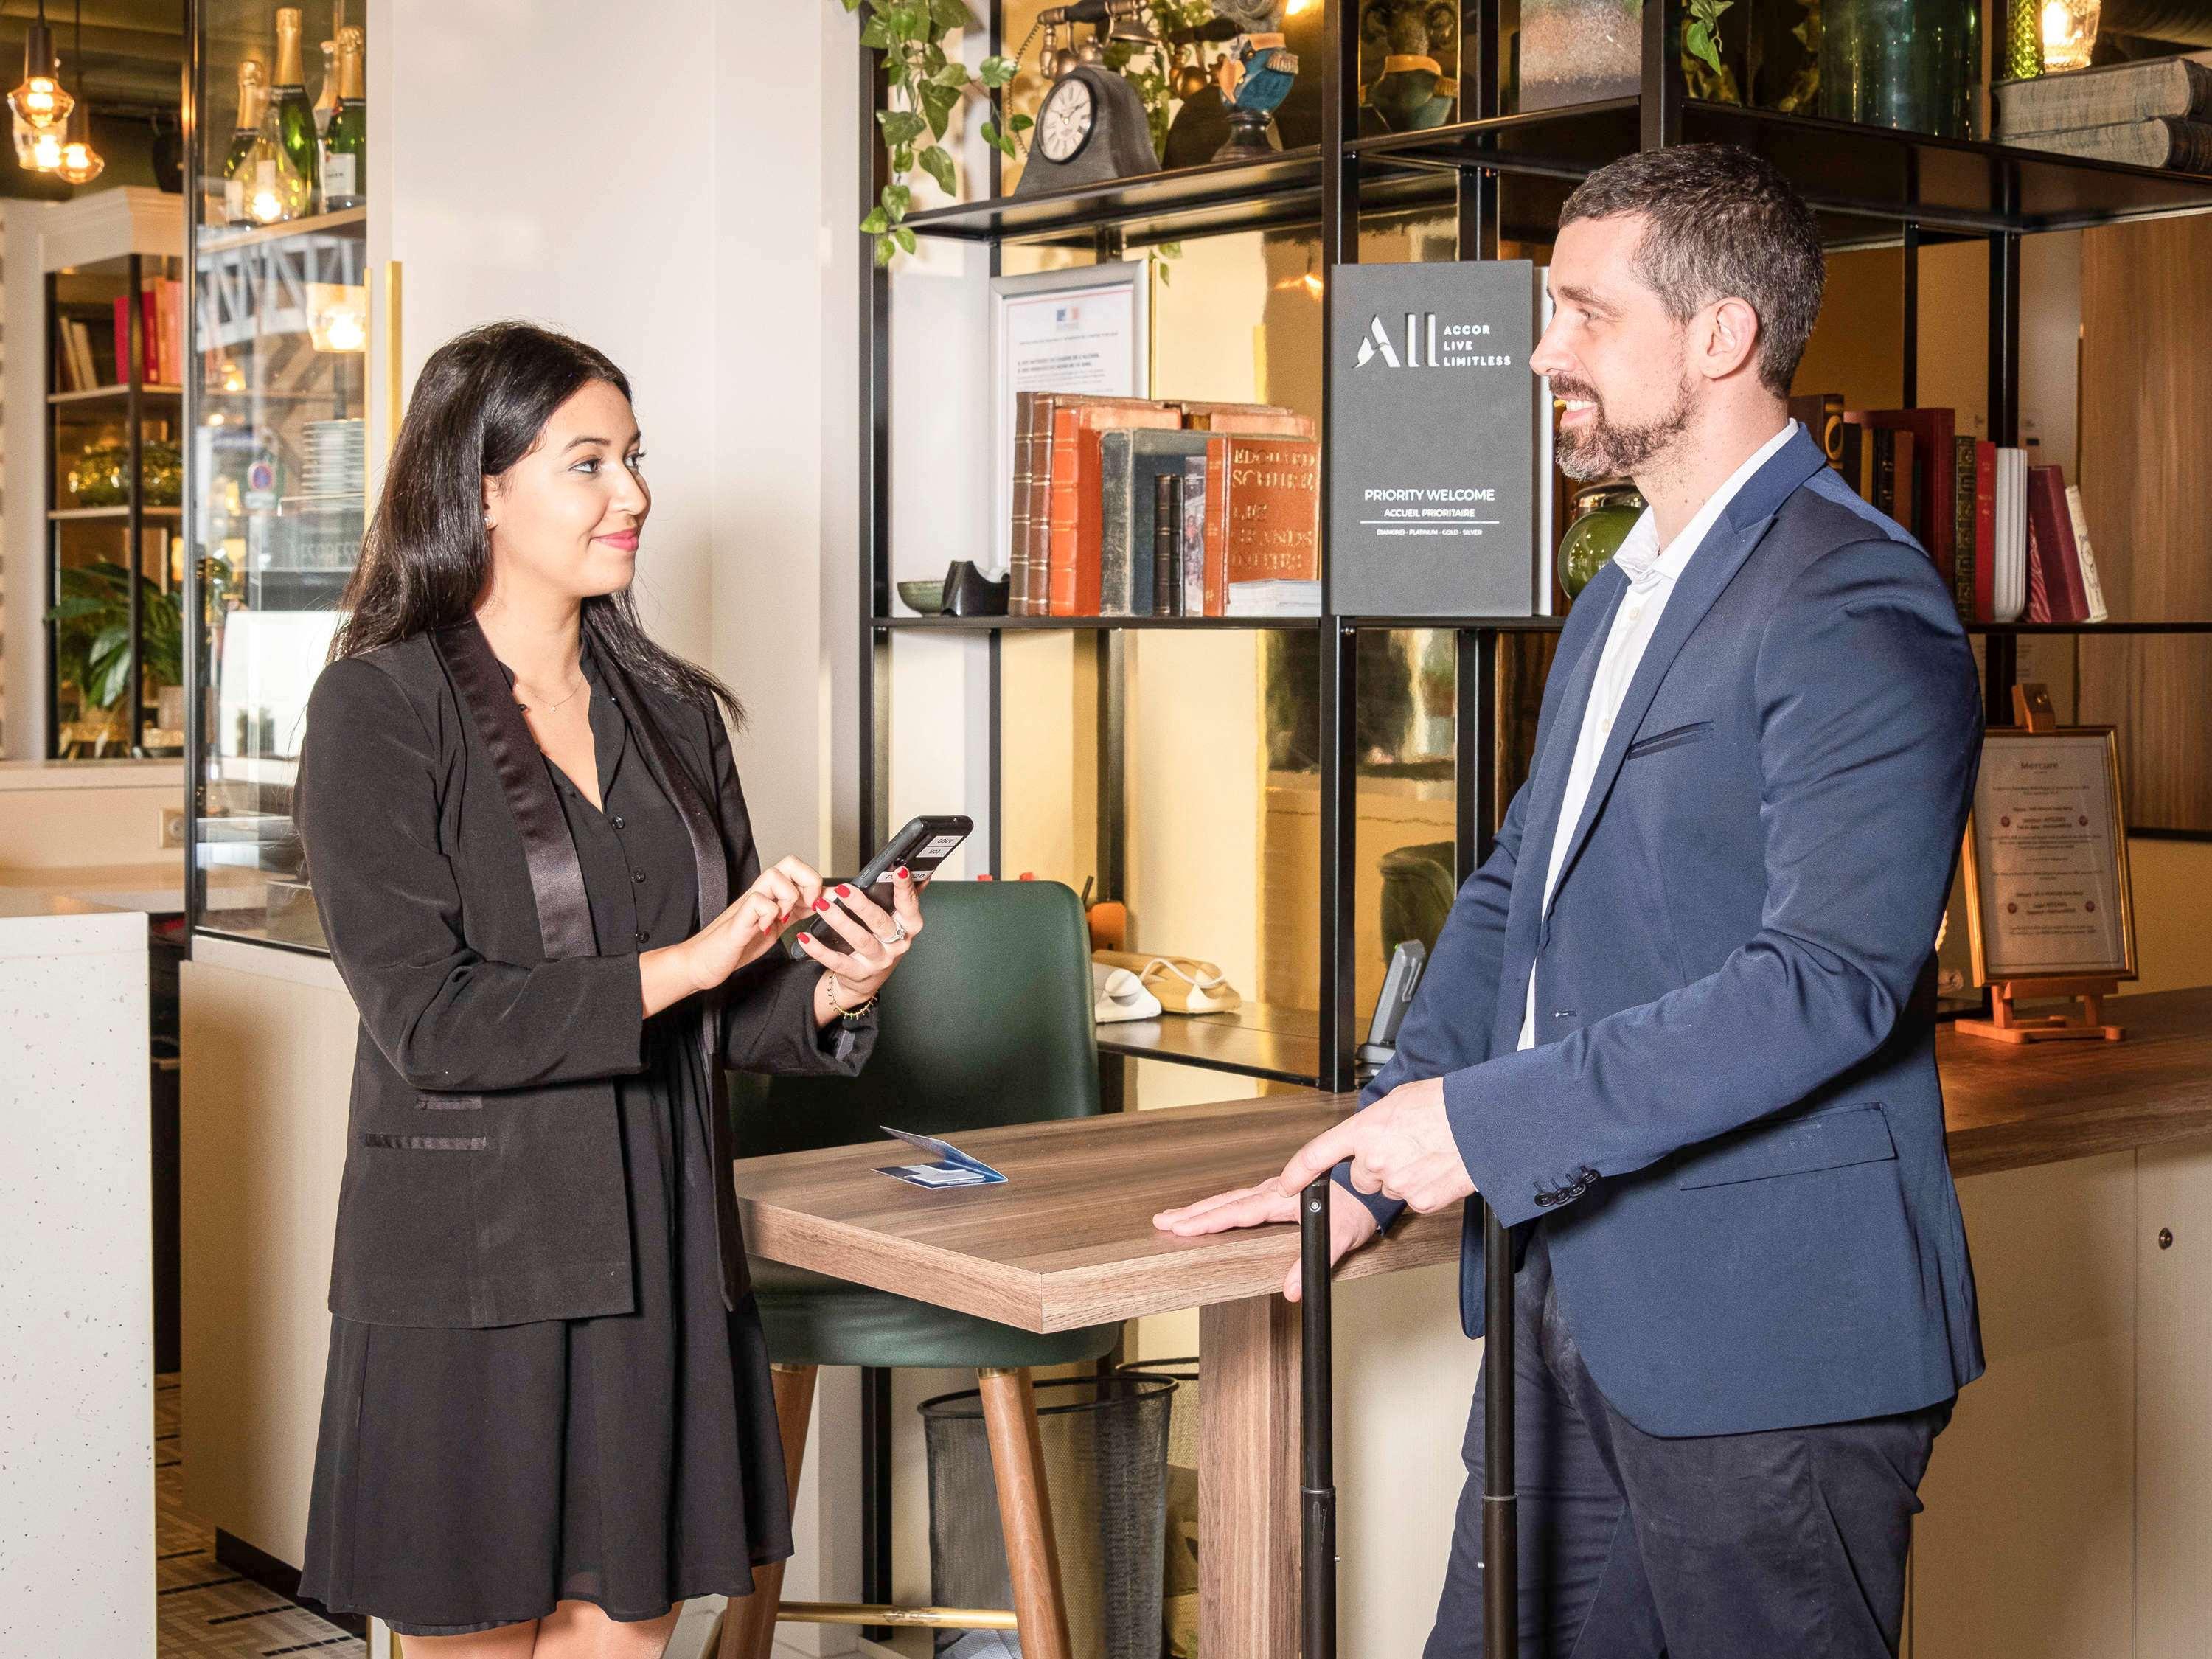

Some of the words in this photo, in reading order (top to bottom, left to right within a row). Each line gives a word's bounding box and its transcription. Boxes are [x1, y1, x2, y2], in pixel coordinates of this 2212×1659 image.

[1443, 324, 1490, 335] ACCOR
[1443, 341, 1473, 351] LIVE
[1443, 355, 1512, 366] LIMITLESS
[1364, 489, 1425, 501] PRIORITY
[1427, 489, 1495, 501] WELCOME
[1383, 509, 1420, 518] ACCUEIL
[1422, 509, 1475, 518] PRIORITAIRE
[2020, 761, 2059, 770] Mercure
